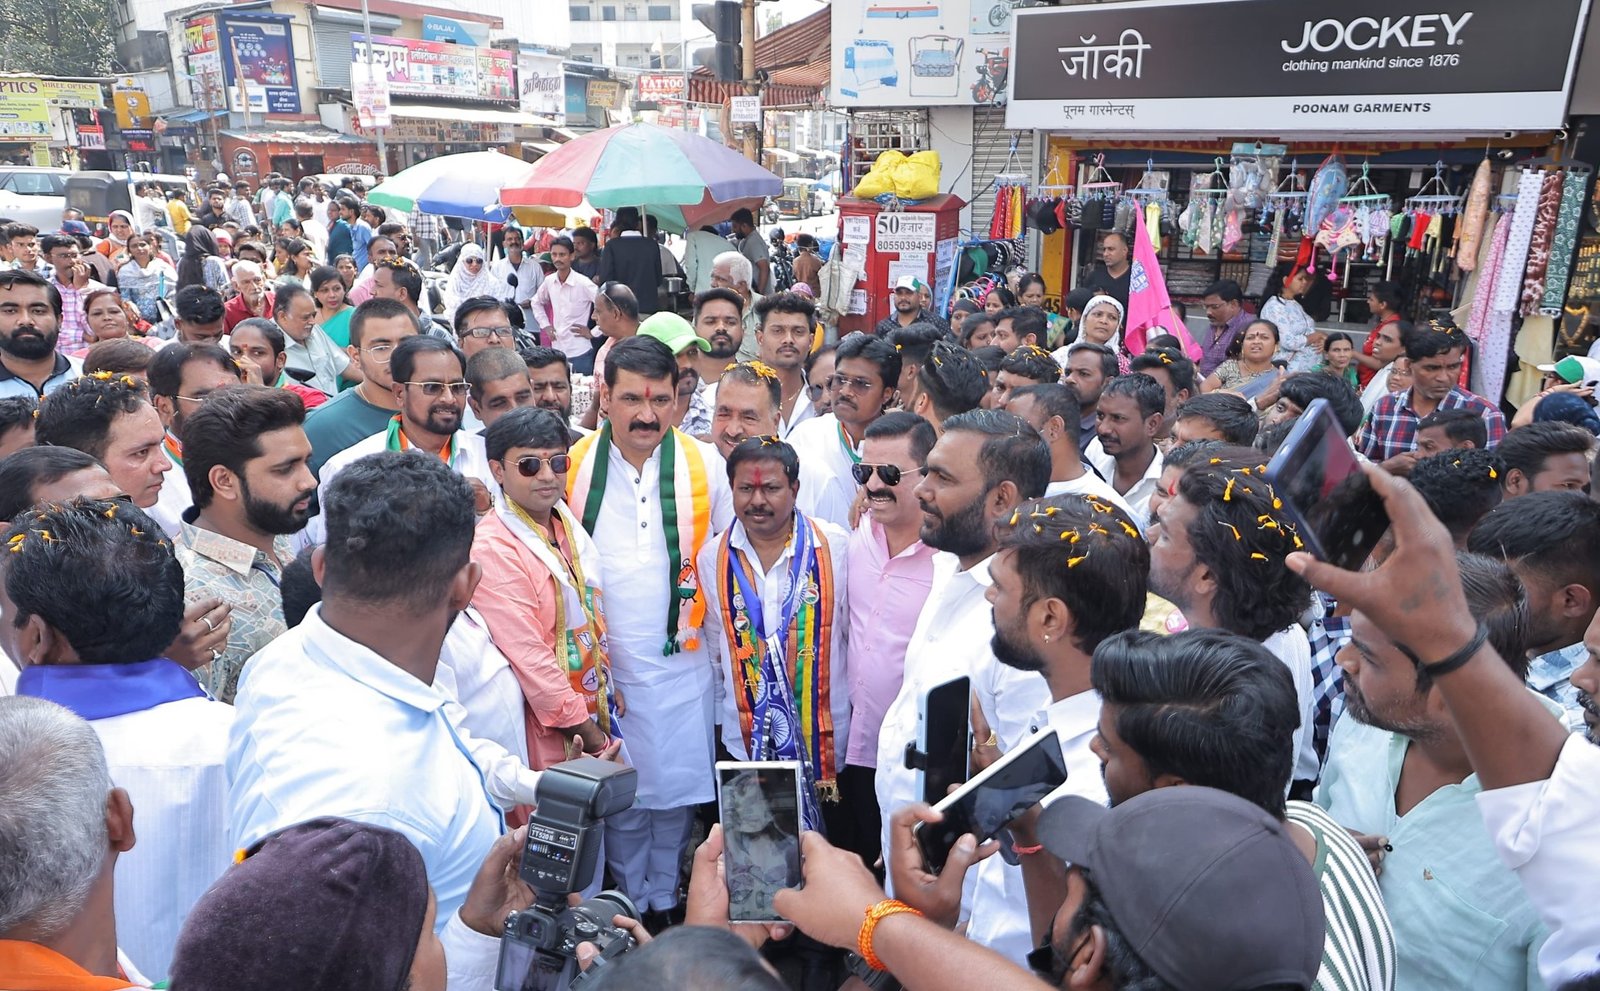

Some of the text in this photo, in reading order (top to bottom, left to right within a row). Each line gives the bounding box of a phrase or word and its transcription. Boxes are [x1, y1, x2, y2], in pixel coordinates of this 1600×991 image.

[1281, 12, 1474, 54] JOCKEY
[1058, 29, 1152, 80] जॉकी
[1282, 54, 1460, 72] clothing mankind since 1876
[641, 79, 684, 88] TATTOO
[1063, 105, 1086, 120] पूनम
[1293, 102, 1432, 114] POONAM GARMENTS
[877, 215, 900, 234] 50
[900, 222, 924, 233] हजार
[877, 240, 933, 250] 8055039495
